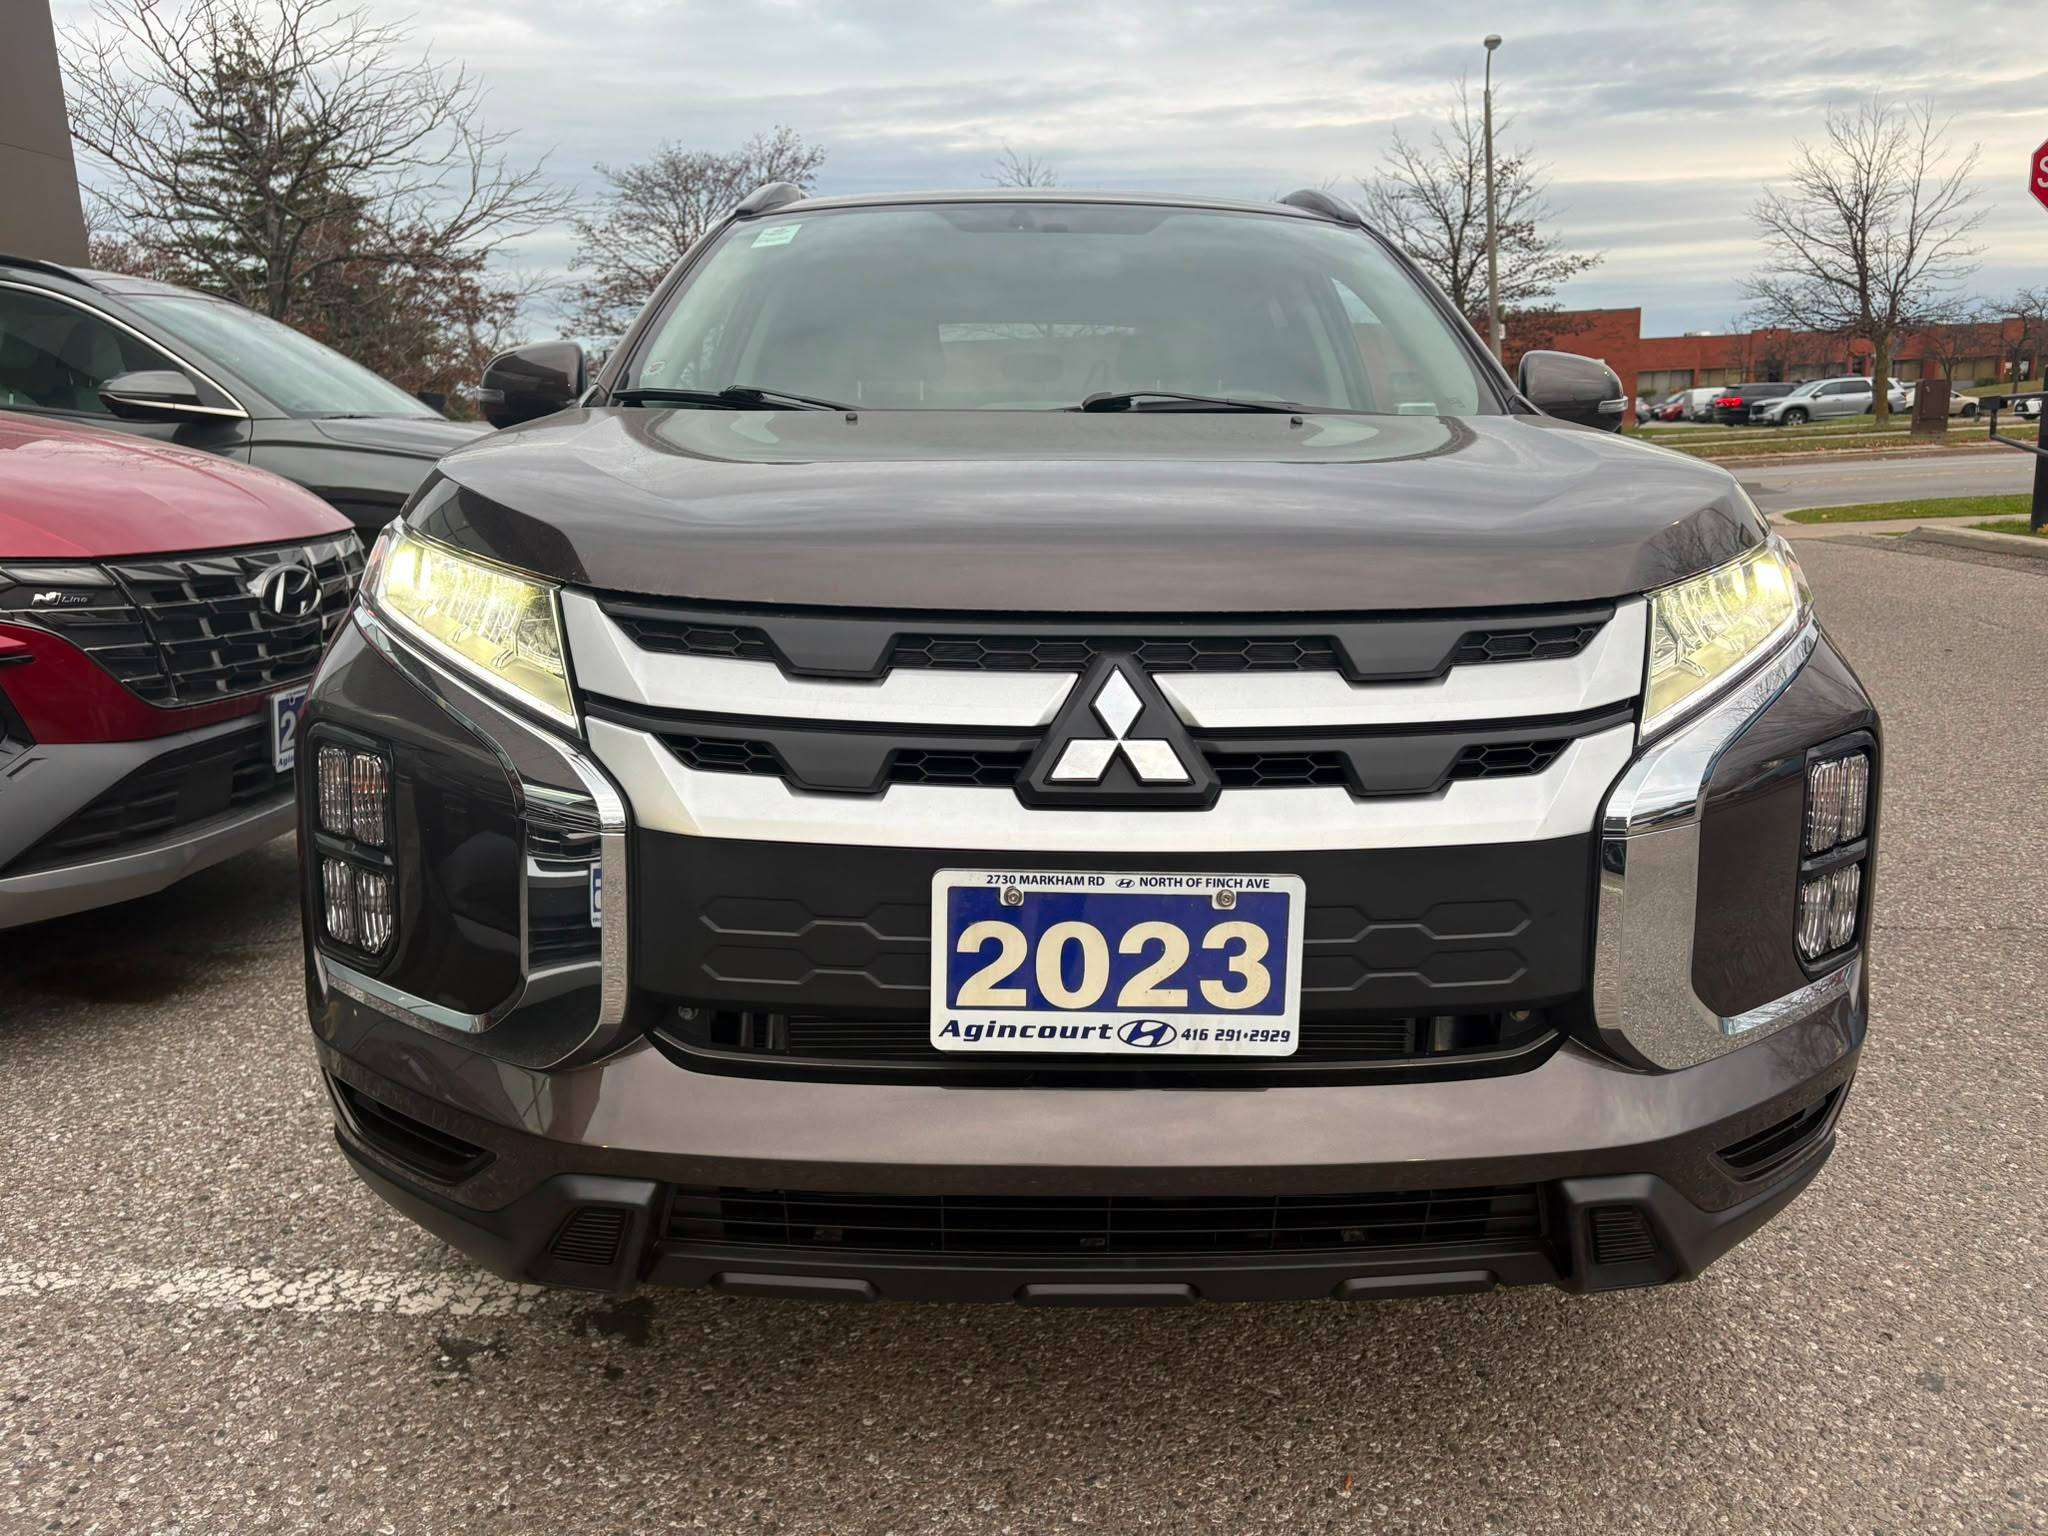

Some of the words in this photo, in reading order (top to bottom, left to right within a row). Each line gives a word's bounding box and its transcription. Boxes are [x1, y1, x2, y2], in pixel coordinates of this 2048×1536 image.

[986, 874, 1016, 885] 2730
[1019, 875, 1085, 886] MARKHAM
[1088, 876, 1105, 887] RD
[1139, 877, 1183, 888] NORTH
[1186, 878, 1202, 888] OF
[1205, 878, 1243, 889] FINCH
[1246, 879, 1270, 889] AVE
[956, 920, 1271, 1010] 2023
[938, 1019, 1113, 1042] Agincourt
[1181, 1028, 1209, 1041] 416
